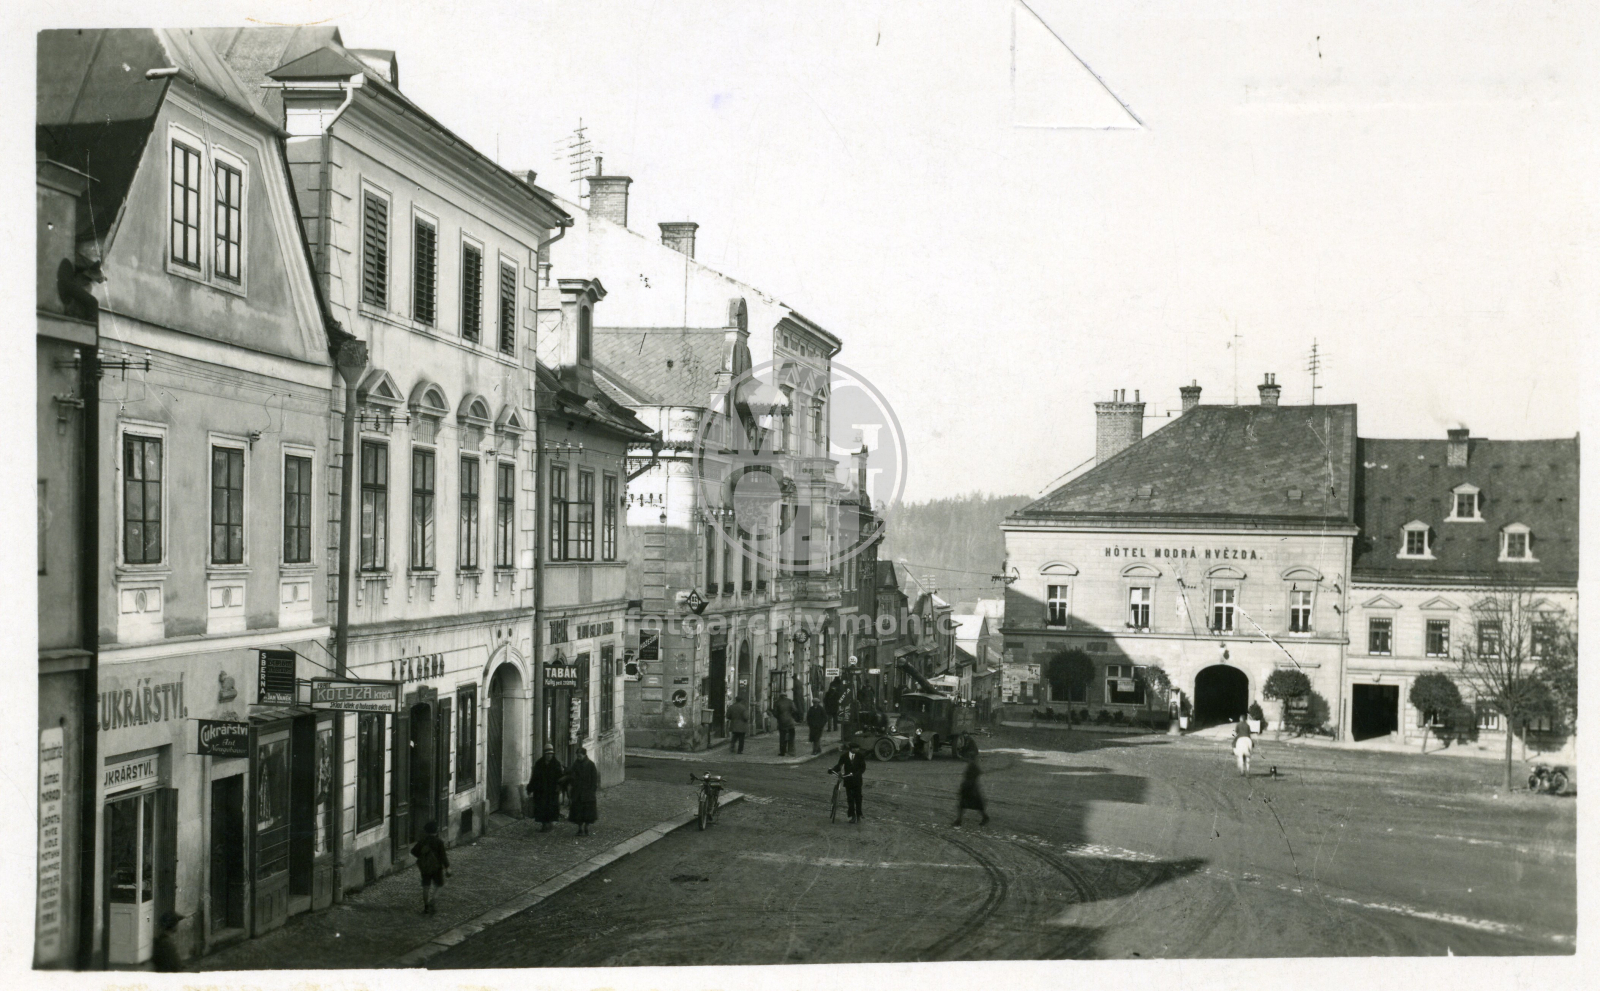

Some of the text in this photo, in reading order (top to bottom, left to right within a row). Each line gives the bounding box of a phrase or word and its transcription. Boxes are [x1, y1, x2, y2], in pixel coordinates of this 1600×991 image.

[1154, 546, 1197, 559] MODRÁ
[545, 665, 578, 678] TABÁK
[316, 687, 372, 701] KOTYZA
